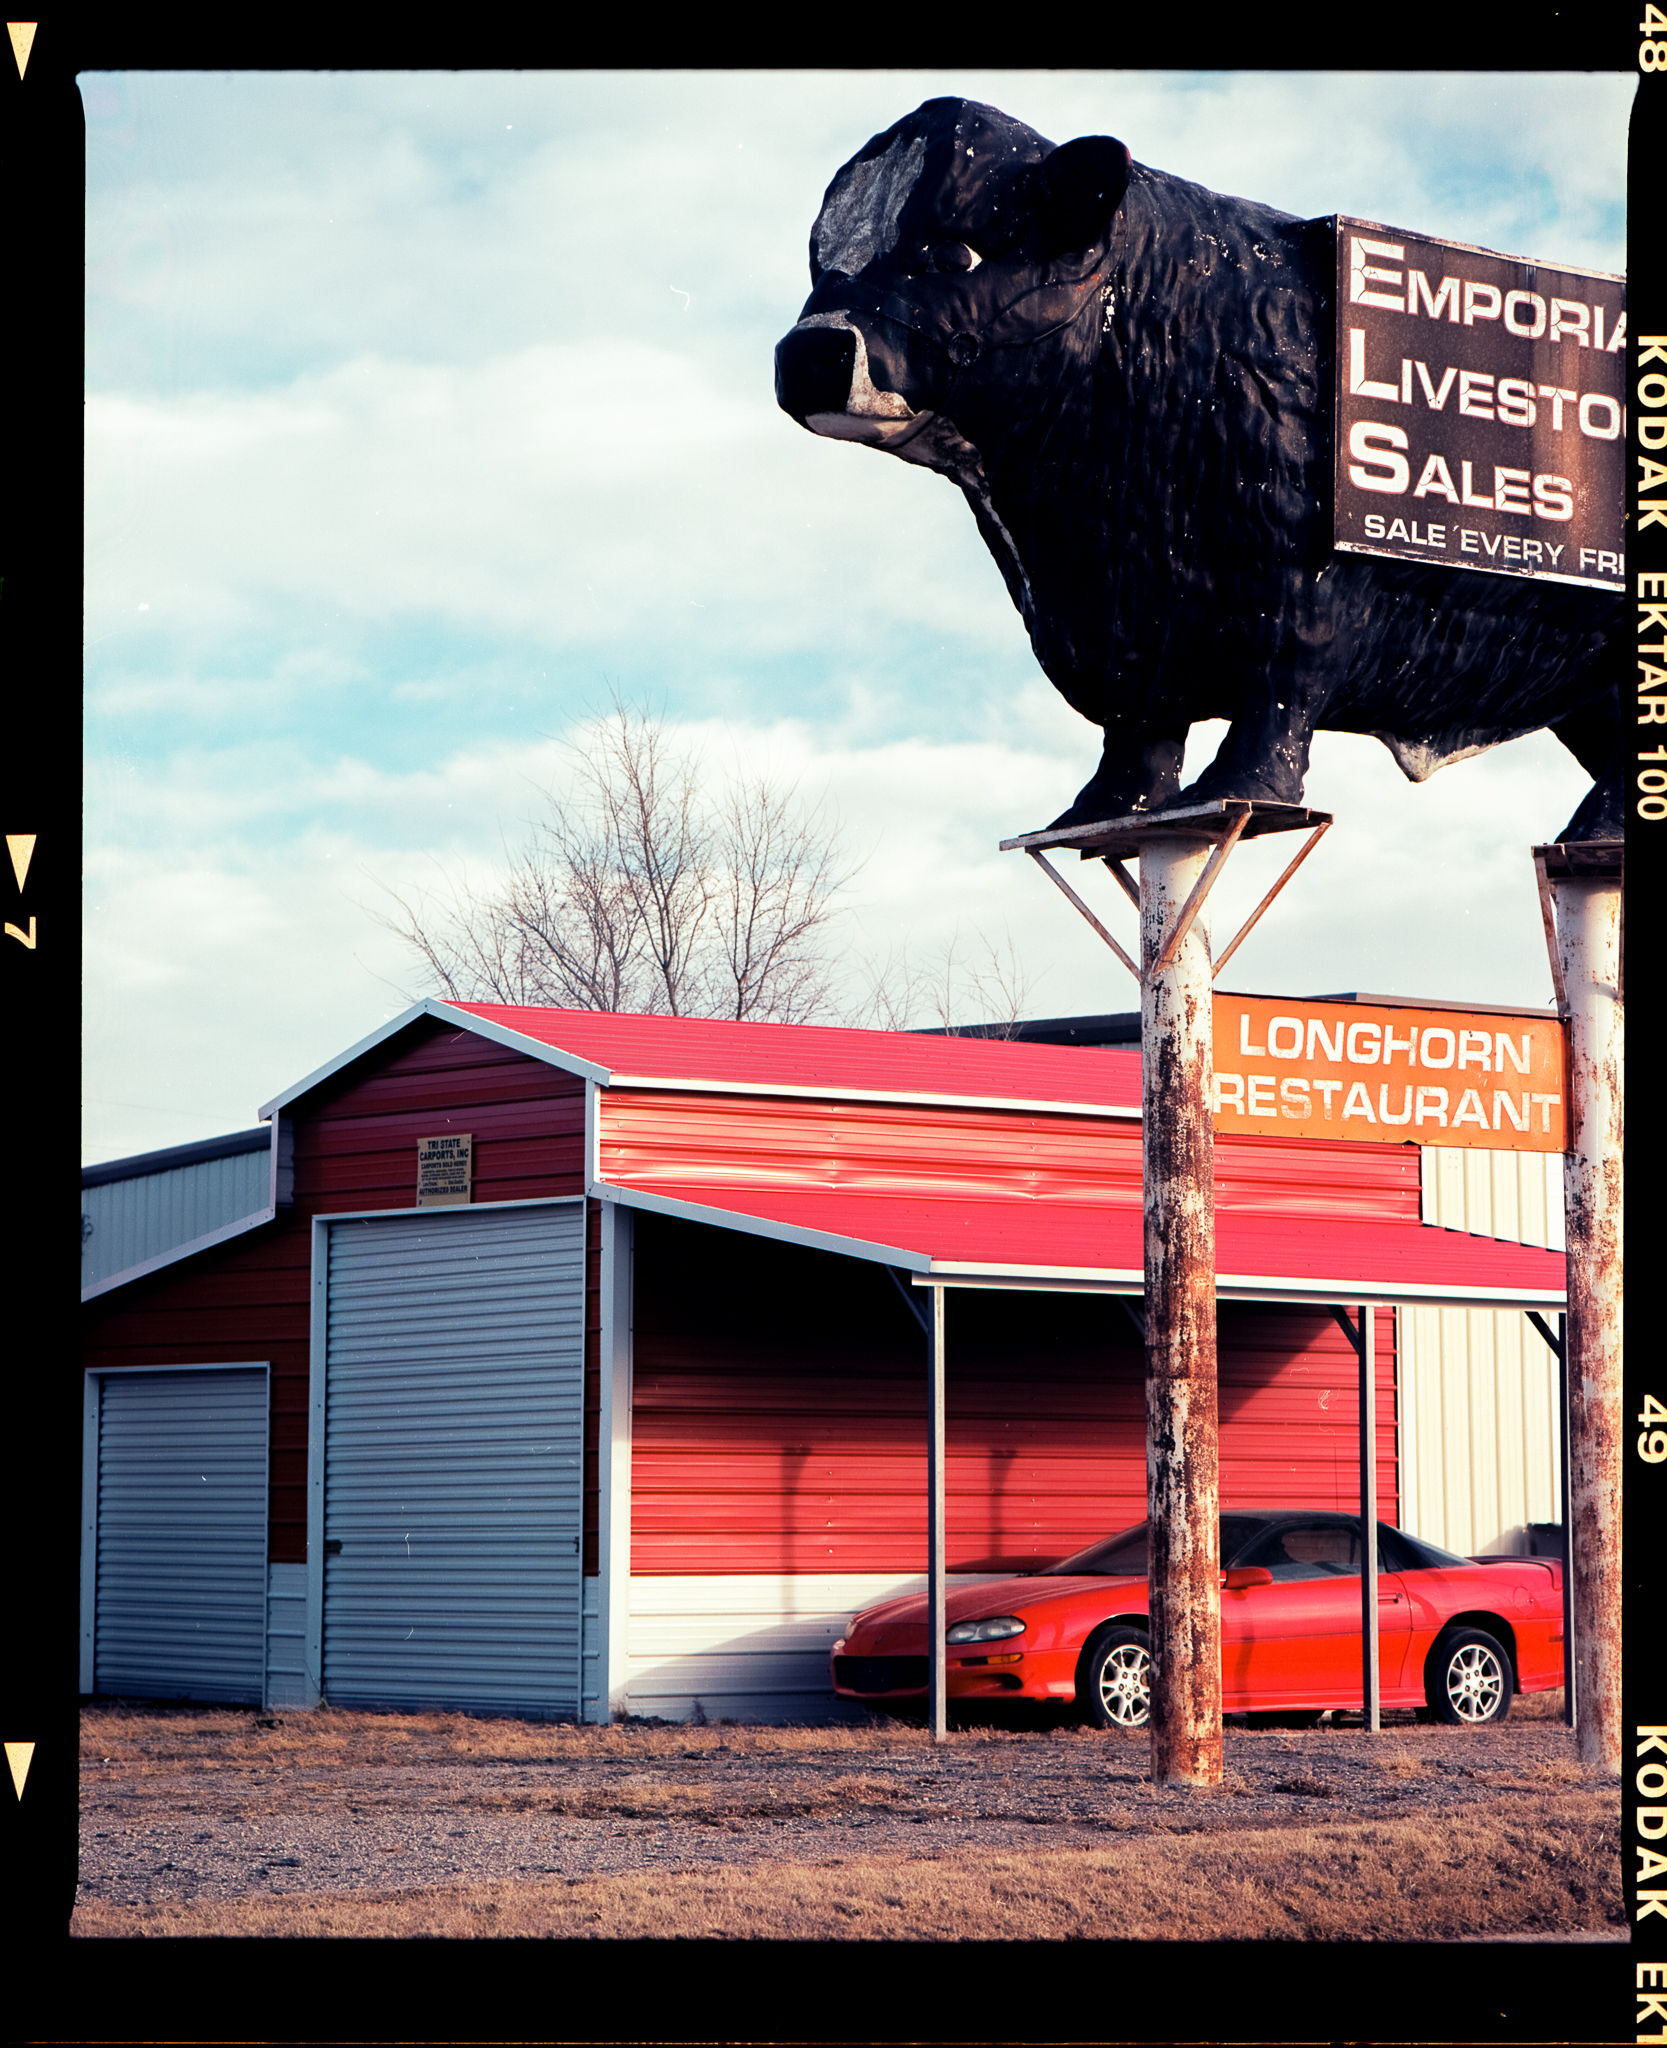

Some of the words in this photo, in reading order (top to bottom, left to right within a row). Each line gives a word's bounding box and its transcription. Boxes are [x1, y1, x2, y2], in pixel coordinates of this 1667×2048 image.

[1639, 3, 1667, 73] 48
[1349, 327, 1626, 441] LIVESTO
[1637, 335, 1667, 531] KODAK
[1348, 420, 1575, 521] SALES
[1364, 514, 1446, 548] SALE
[1461, 529, 1565, 565] EVERY
[1637, 572, 1667, 724] EKTAR
[1637, 744, 1667, 821] 100
[1240, 1014, 1530, 1075] LONGHORN
[1213, 1072, 1560, 1133] RESTAURANT
[420, 1149, 456, 1161] CARPORTS,
[457, 1148, 469, 1158] INC
[427, 1140, 439, 1150] TRI
[440, 1138, 461, 1149] STATE
[419, 1186, 449, 1195] AUTHORIZED
[450, 1185, 468, 1193] DEALER
[1637, 1394, 1667, 1464] 49
[1636, 1726, 1667, 1921] KODAK
